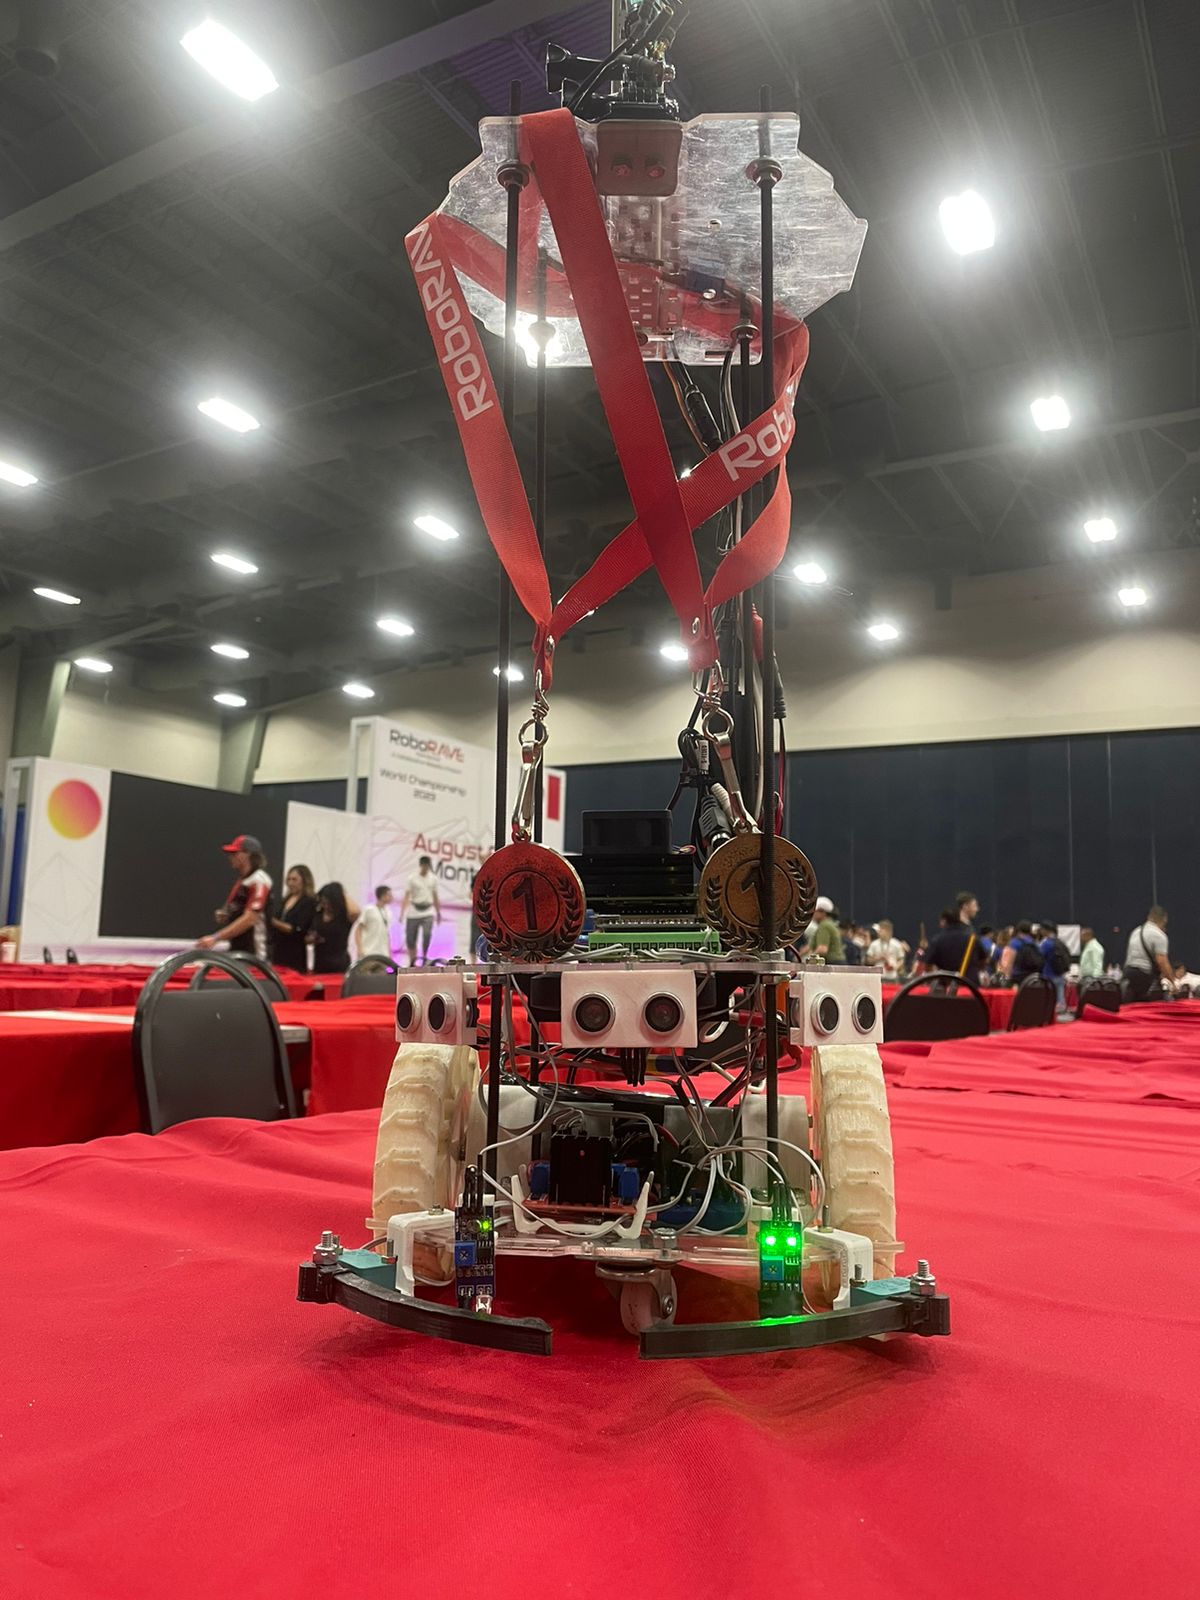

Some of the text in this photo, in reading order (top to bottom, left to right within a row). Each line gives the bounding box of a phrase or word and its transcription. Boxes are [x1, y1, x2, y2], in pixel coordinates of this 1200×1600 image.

[389, 728, 465, 763] RoboRAVE
[379, 768, 467, 797] World Championship
[511, 876, 539, 932] 1
